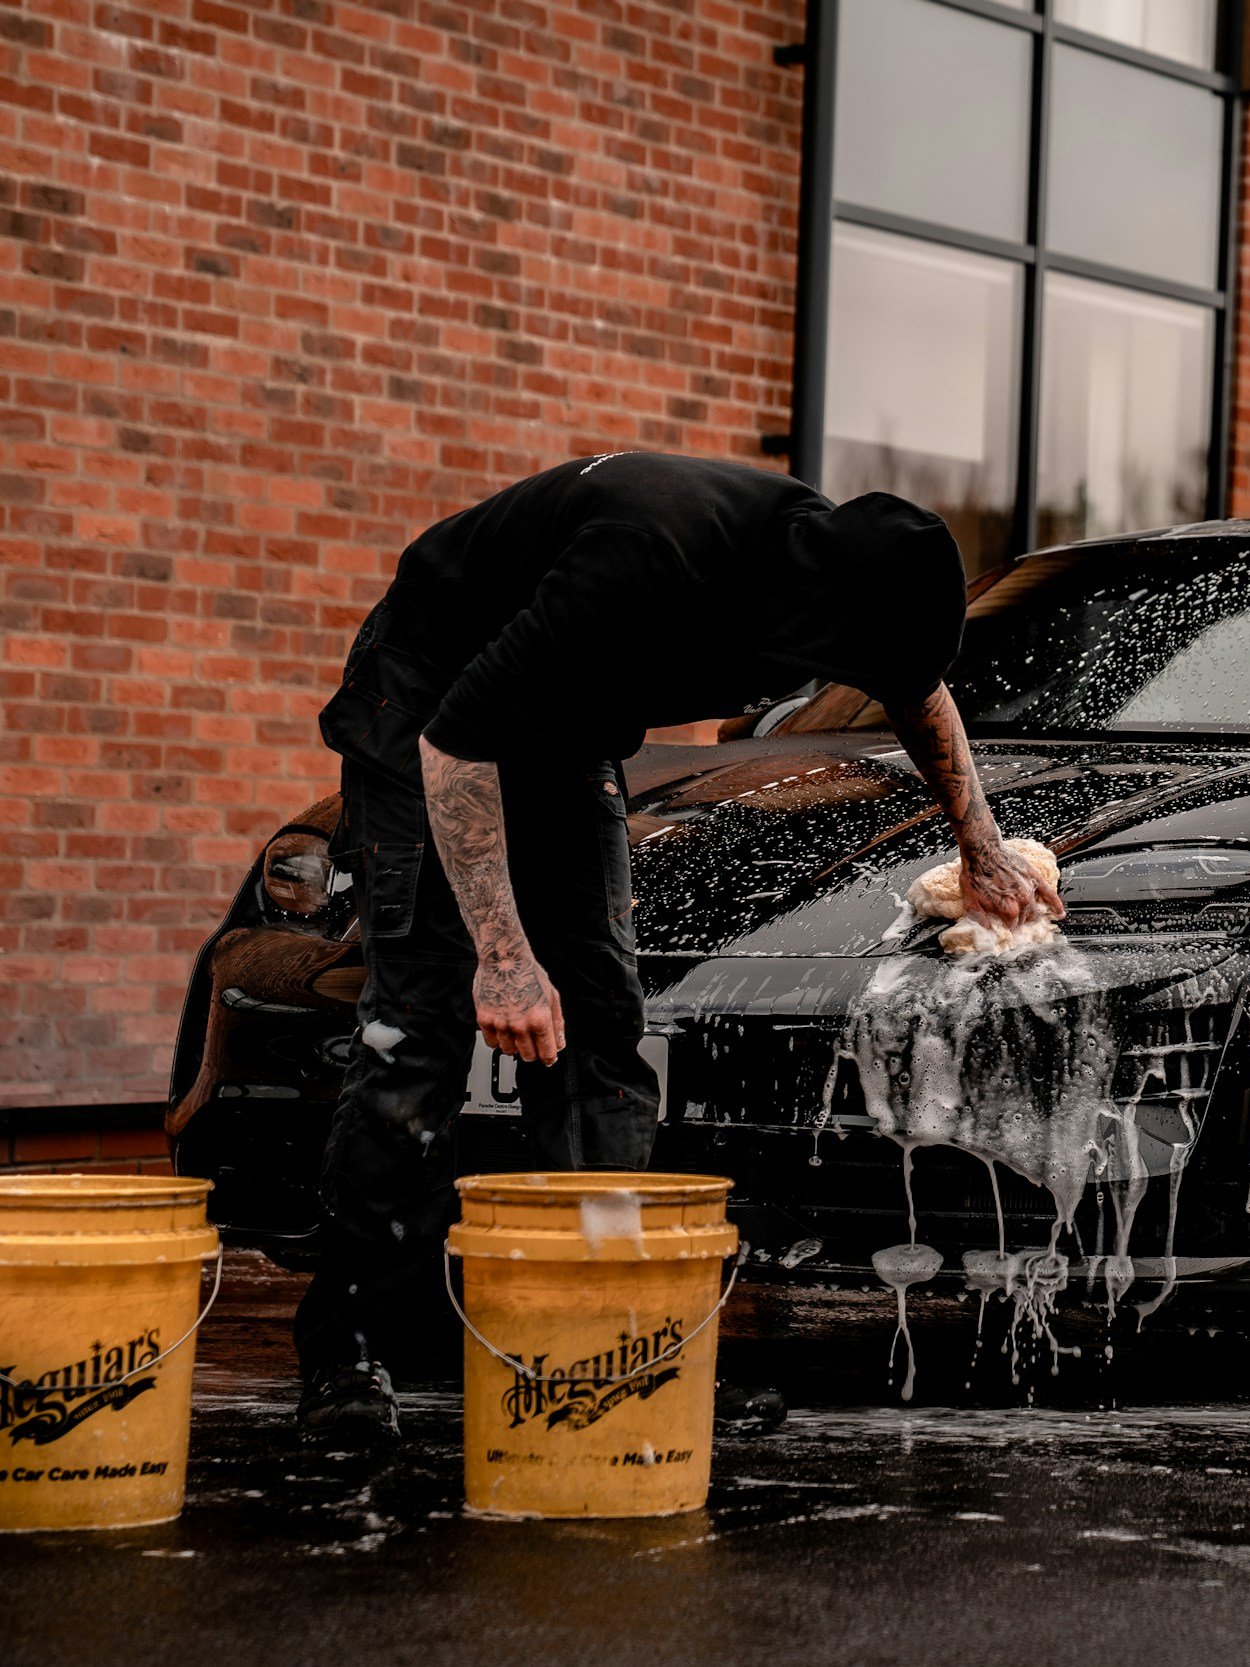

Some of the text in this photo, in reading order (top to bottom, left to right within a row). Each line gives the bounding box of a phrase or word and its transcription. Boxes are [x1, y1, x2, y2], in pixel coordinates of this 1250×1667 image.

[501, 1316, 686, 1429] Meguiar's
[622, 1450, 663, 1466] Mae
[666, 1449, 693, 1464] Easy
[12, 1467, 44, 1482] Car
[48, 1466, 89, 1481] Care
[93, 1462, 137, 1480] Made
[141, 1460, 169, 1476] Easy
